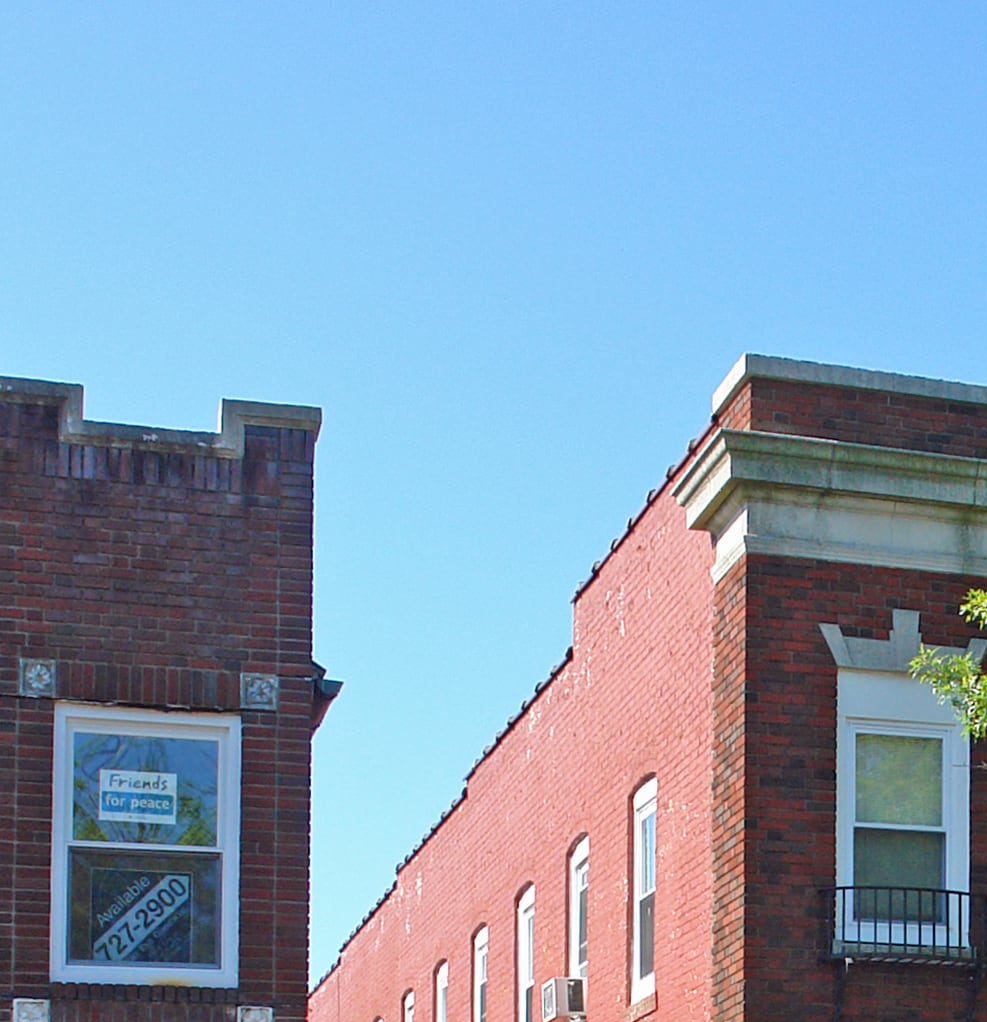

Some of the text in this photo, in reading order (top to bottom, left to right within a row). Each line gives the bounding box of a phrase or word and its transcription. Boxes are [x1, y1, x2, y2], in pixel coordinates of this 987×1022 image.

[108, 773, 169, 791] Friends
[105, 793, 170, 811] for peace
[95, 878, 187, 960] 727-2900
[96, 876, 151, 928] Available
